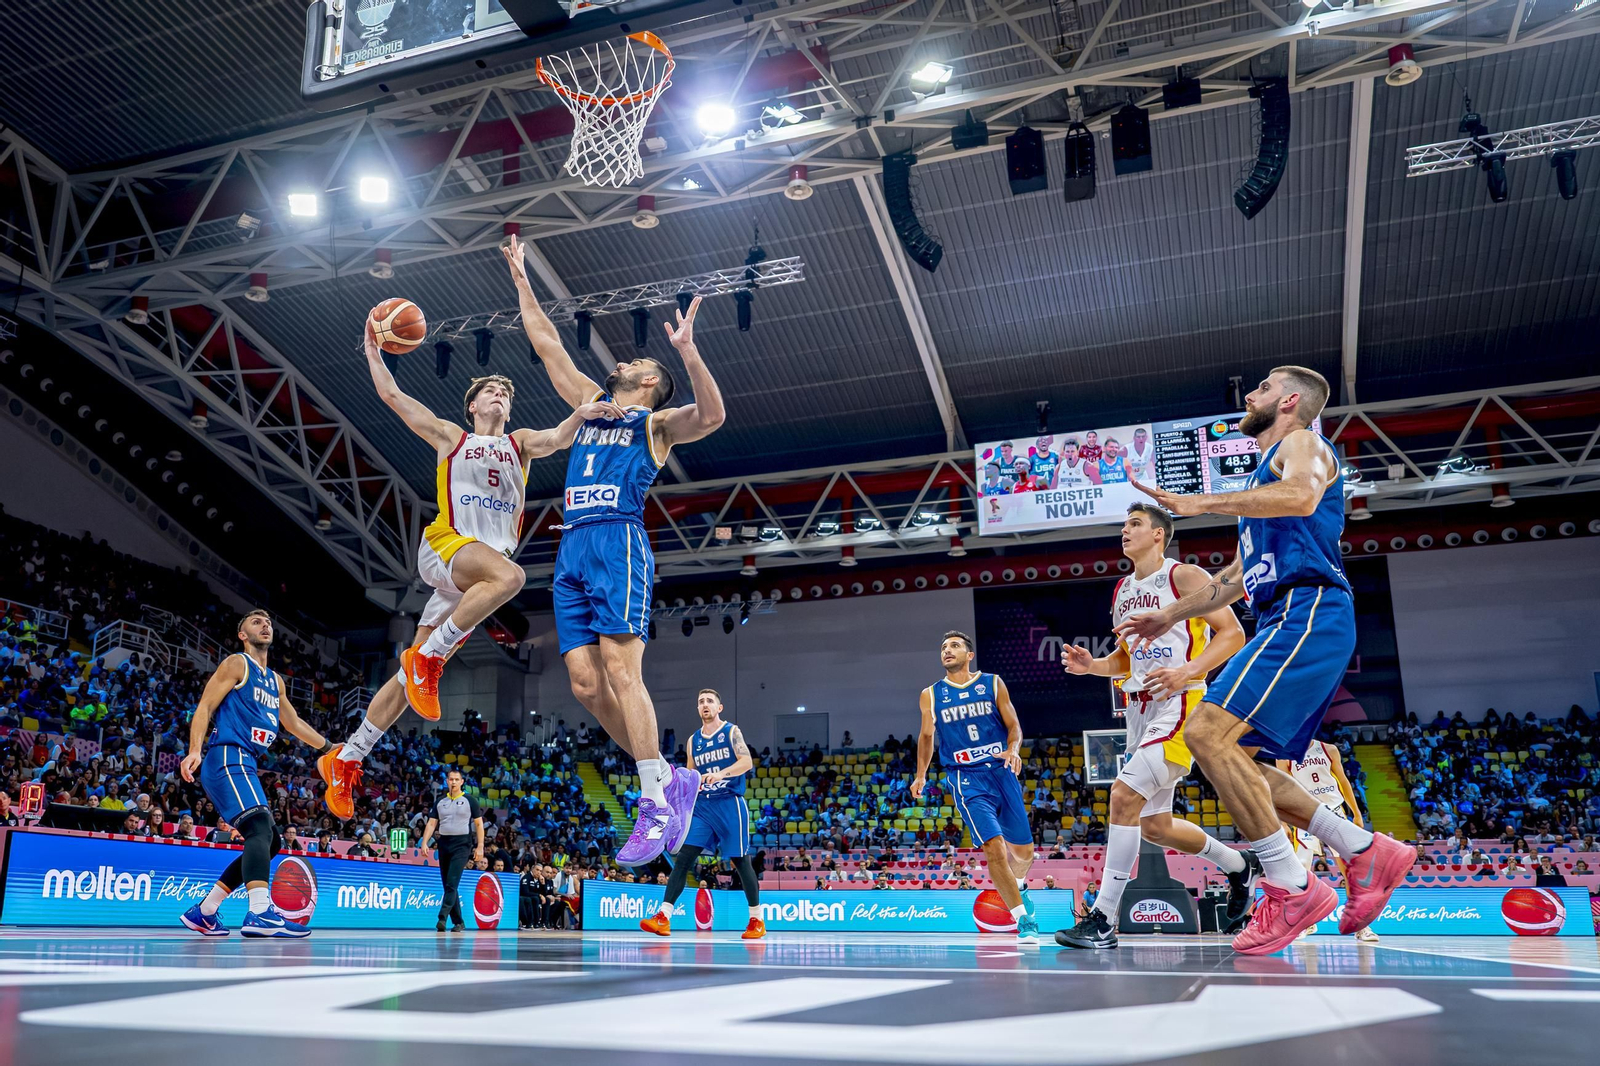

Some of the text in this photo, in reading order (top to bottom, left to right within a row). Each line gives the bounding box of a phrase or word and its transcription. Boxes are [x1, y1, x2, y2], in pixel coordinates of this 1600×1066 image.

[1172, 421, 1192, 429] SPAIN
[1212, 444, 1227, 454] 65
[583, 453, 596, 477] 1
[1035, 464, 1055, 472] USA
[1226, 455, 1250, 466] 48.3
[488, 468, 500, 487] 5
[574, 489, 615, 504] EKO
[1035, 488, 1103, 504] REGISTER
[460, 494, 516, 514] endesa
[1045, 501, 1095, 519] NOW!
[1119, 592, 1160, 617] ESPAÑA
[1134, 646, 1172, 661] desa
[266, 712, 277, 727] 9
[941, 701, 993, 723] CYPRUS
[967, 724, 979, 741] 6
[694, 747, 730, 766] CYPRUS
[970, 746, 1001, 758] EKO
[1296, 757, 1327, 771] ESPAÑA
[1312, 772, 1319, 782] 8
[1309, 785, 1335, 795] ndesa
[42, 866, 152, 901] molten
[186, 882, 209, 898] the
[337, 882, 400, 909] molten
[600, 893, 643, 918] molten
[760, 900, 844, 921] molten
[877, 906, 898, 919] the
[1139, 903, 1168, 911] 百岁山
[1405, 908, 1427, 919] the
